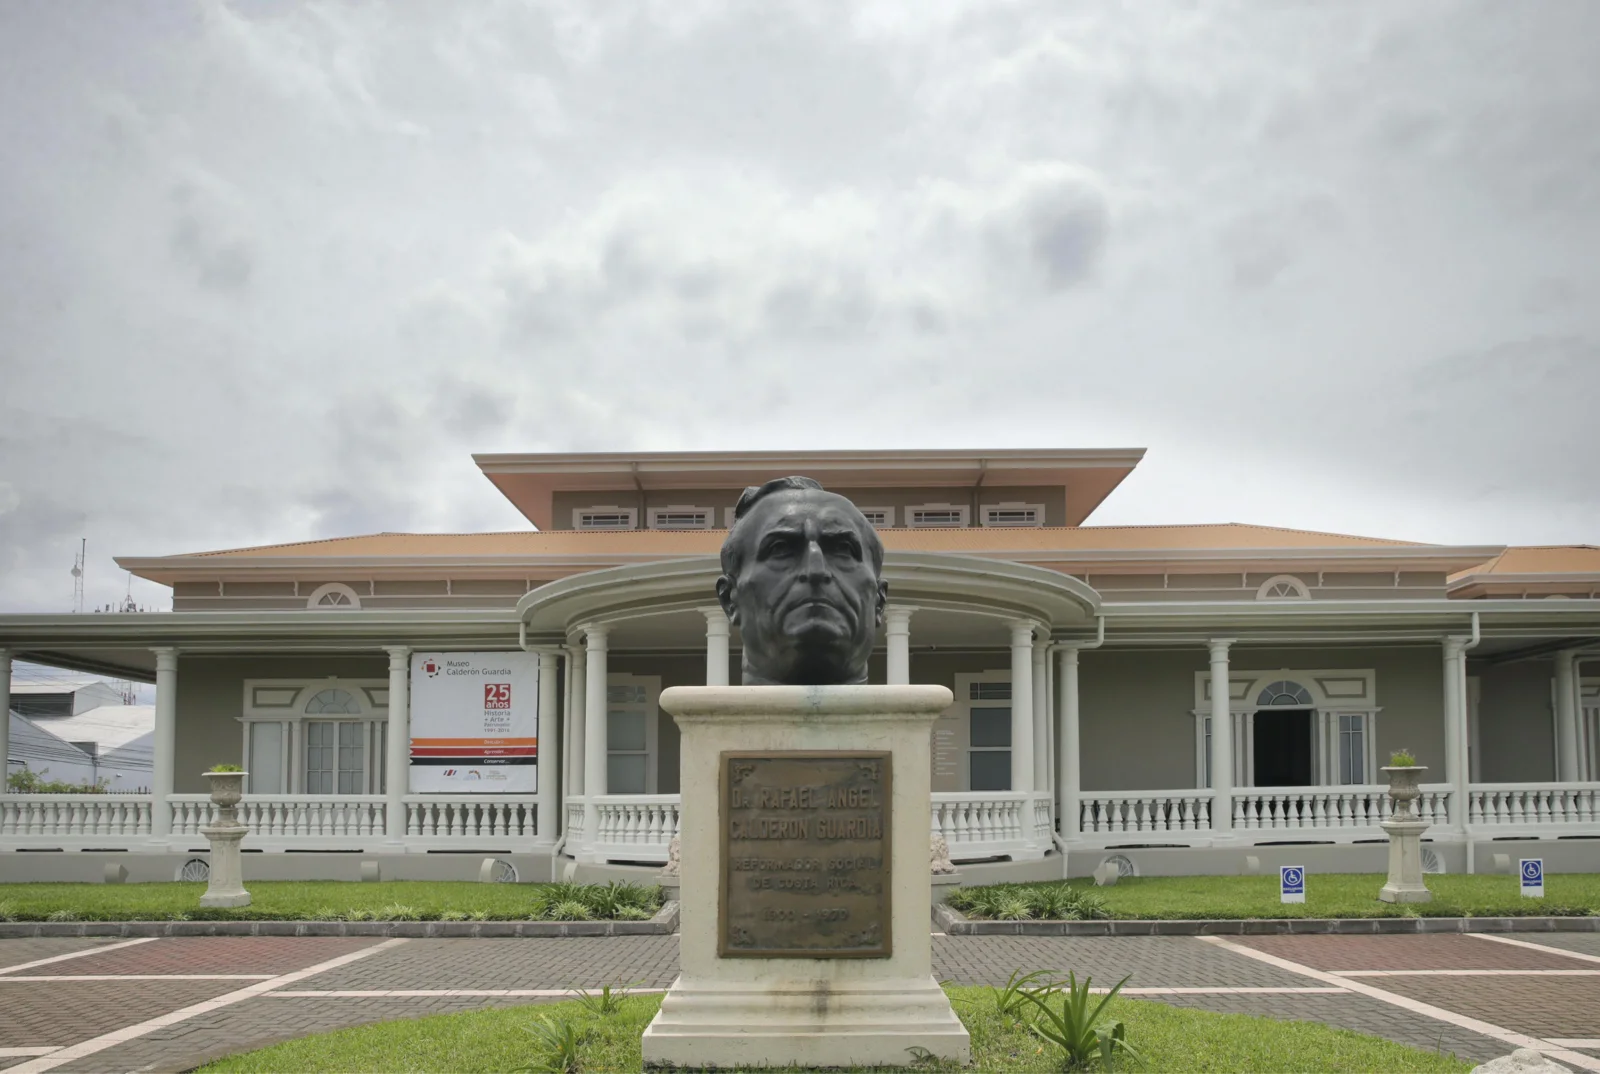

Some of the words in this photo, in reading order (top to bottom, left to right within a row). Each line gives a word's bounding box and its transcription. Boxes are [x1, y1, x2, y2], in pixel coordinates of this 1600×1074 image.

[446, 667, 480, 676] Calderón
[482, 668, 512, 676] Guardia
[486, 685, 509, 701] 25
[486, 700, 509, 709] años
[761, 787, 818, 809] RAFAEL
[828, 787, 881, 809] ANGEL
[817, 818, 883, 839] GUARDIA
[828, 858, 877, 870] SOCIAL
